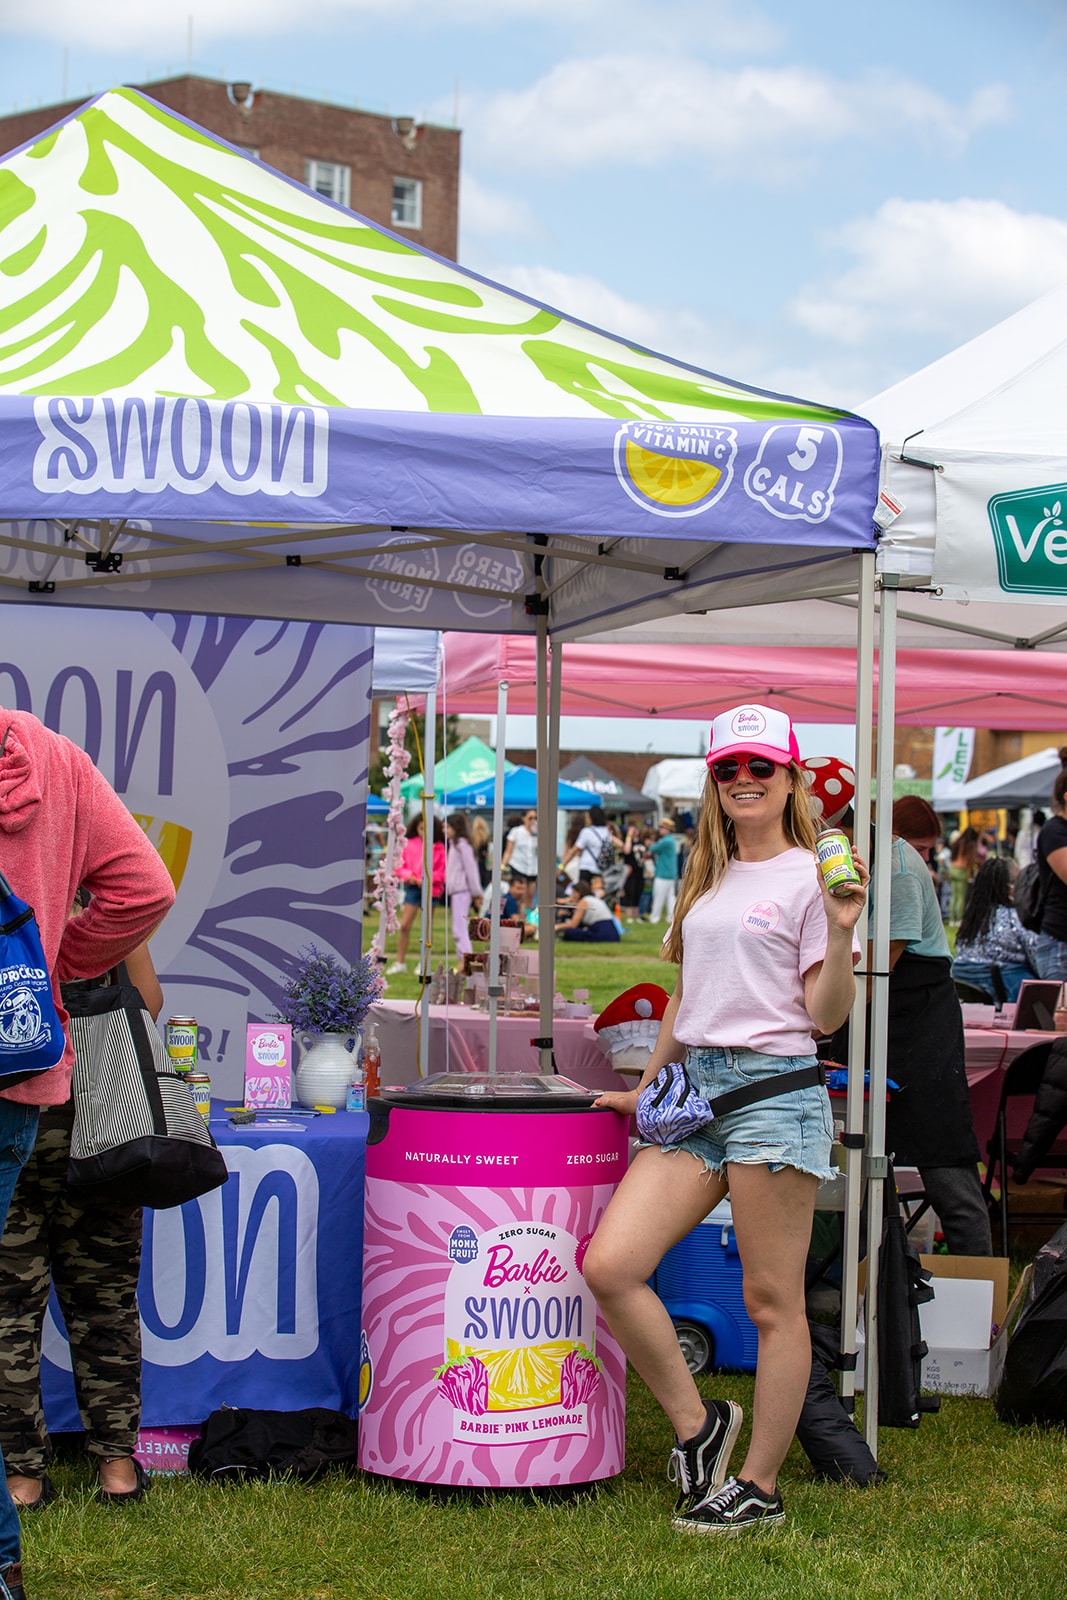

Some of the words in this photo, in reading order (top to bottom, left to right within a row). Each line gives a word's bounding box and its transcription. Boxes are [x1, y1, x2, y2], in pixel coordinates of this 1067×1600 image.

[680, 427, 725, 440] DAILY
[633, 426, 710, 456] VITAMIN
[714, 444, 726, 459] C
[787, 428, 823, 471] 5
[752, 467, 826, 515] CALS
[405, 1151, 471, 1165] NATURALLY
[475, 1155, 519, 1166] SWEET
[566, 1154, 593, 1165] ZERO
[595, 1152, 619, 1163] SUGAR
[498, 1228, 524, 1241] ZERO
[526, 1227, 557, 1240] SUGAR
[451, 1239, 478, 1249] MONK
[450, 1248, 477, 1259] FRUIT
[483, 1244, 568, 1288] Barbie
[464, 1295, 583, 1339] SWOON
[505, 1421, 529, 1434] PINK
[532, 1414, 583, 1430] LEMONADE
[136, 1442, 190, 1456] SWEET
